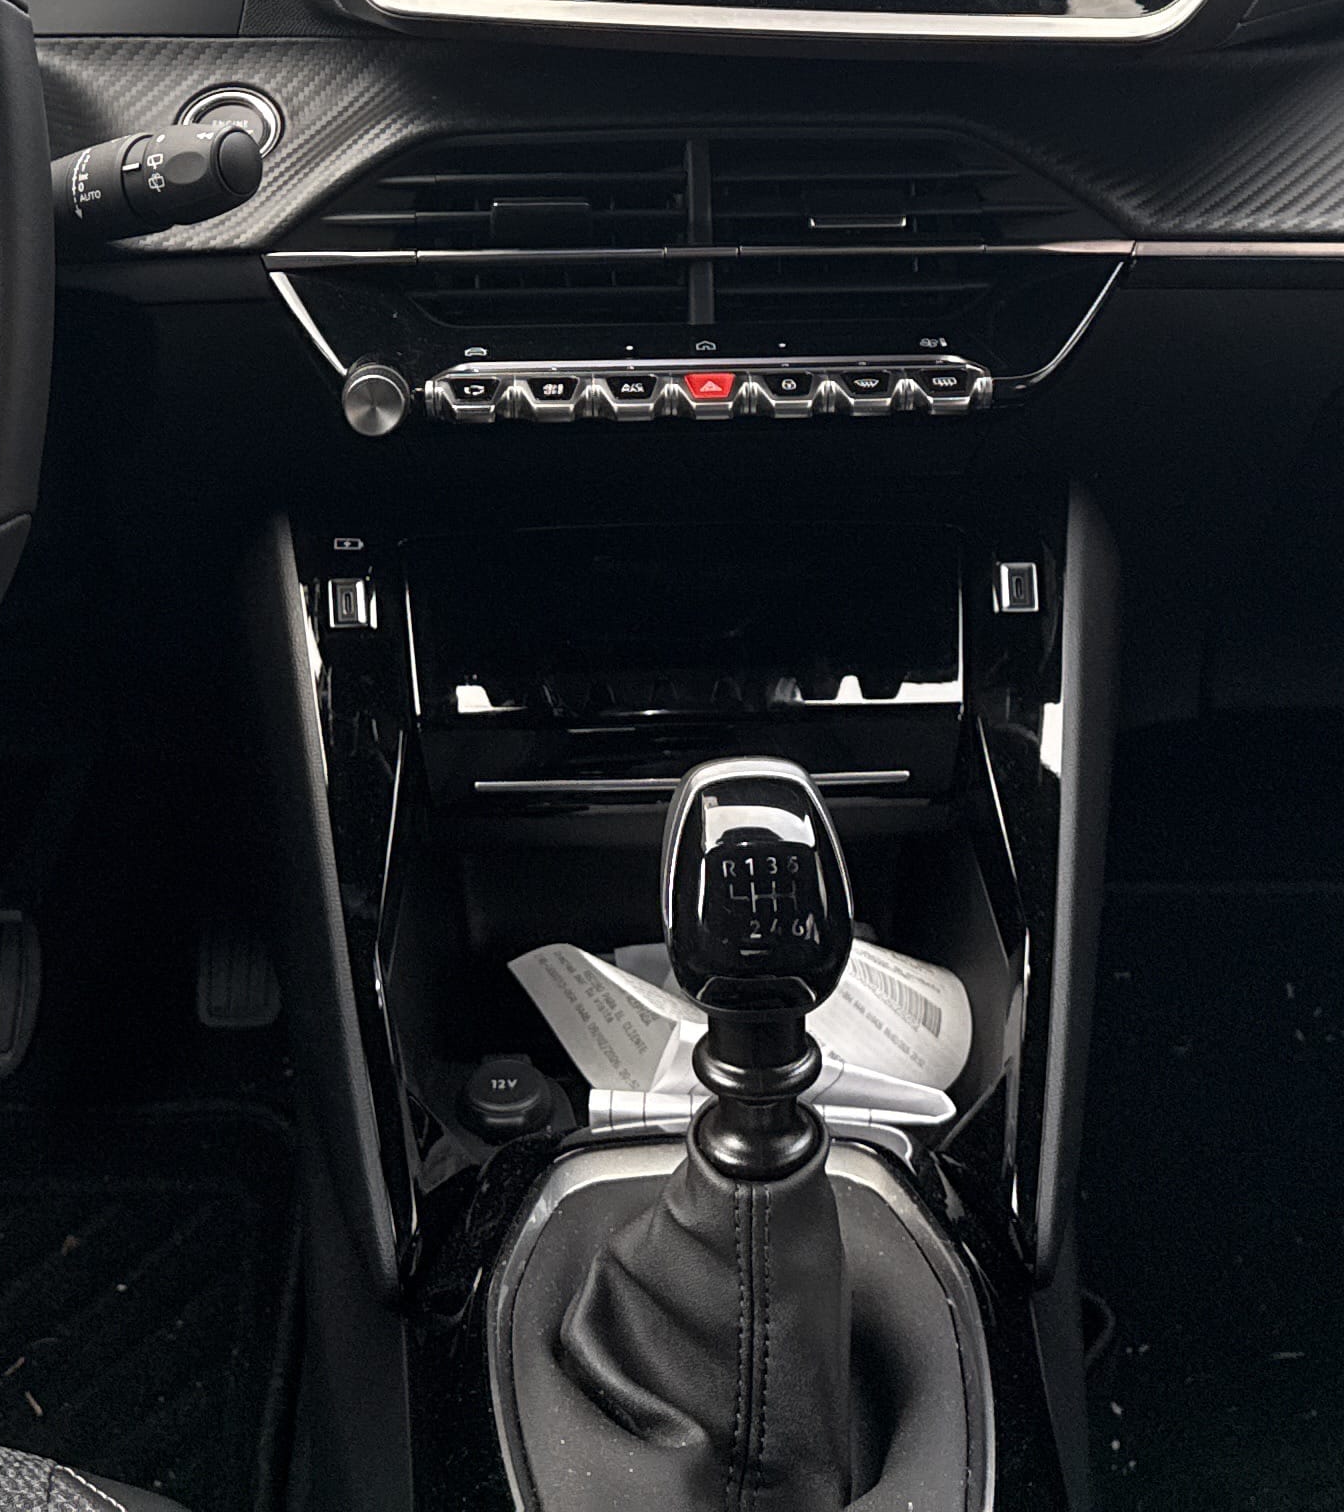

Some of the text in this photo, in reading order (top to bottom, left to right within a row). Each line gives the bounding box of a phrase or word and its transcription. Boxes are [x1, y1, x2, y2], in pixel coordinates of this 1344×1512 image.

[79, 189, 101, 203] AUTO
[722, 859, 736, 878] R
[745, 857, 754, 876] 1
[766, 856, 778, 874] 3
[750, 919, 762, 939] 2
[791, 918, 805, 937] 6
[489, 1078, 518, 1091] 12V
